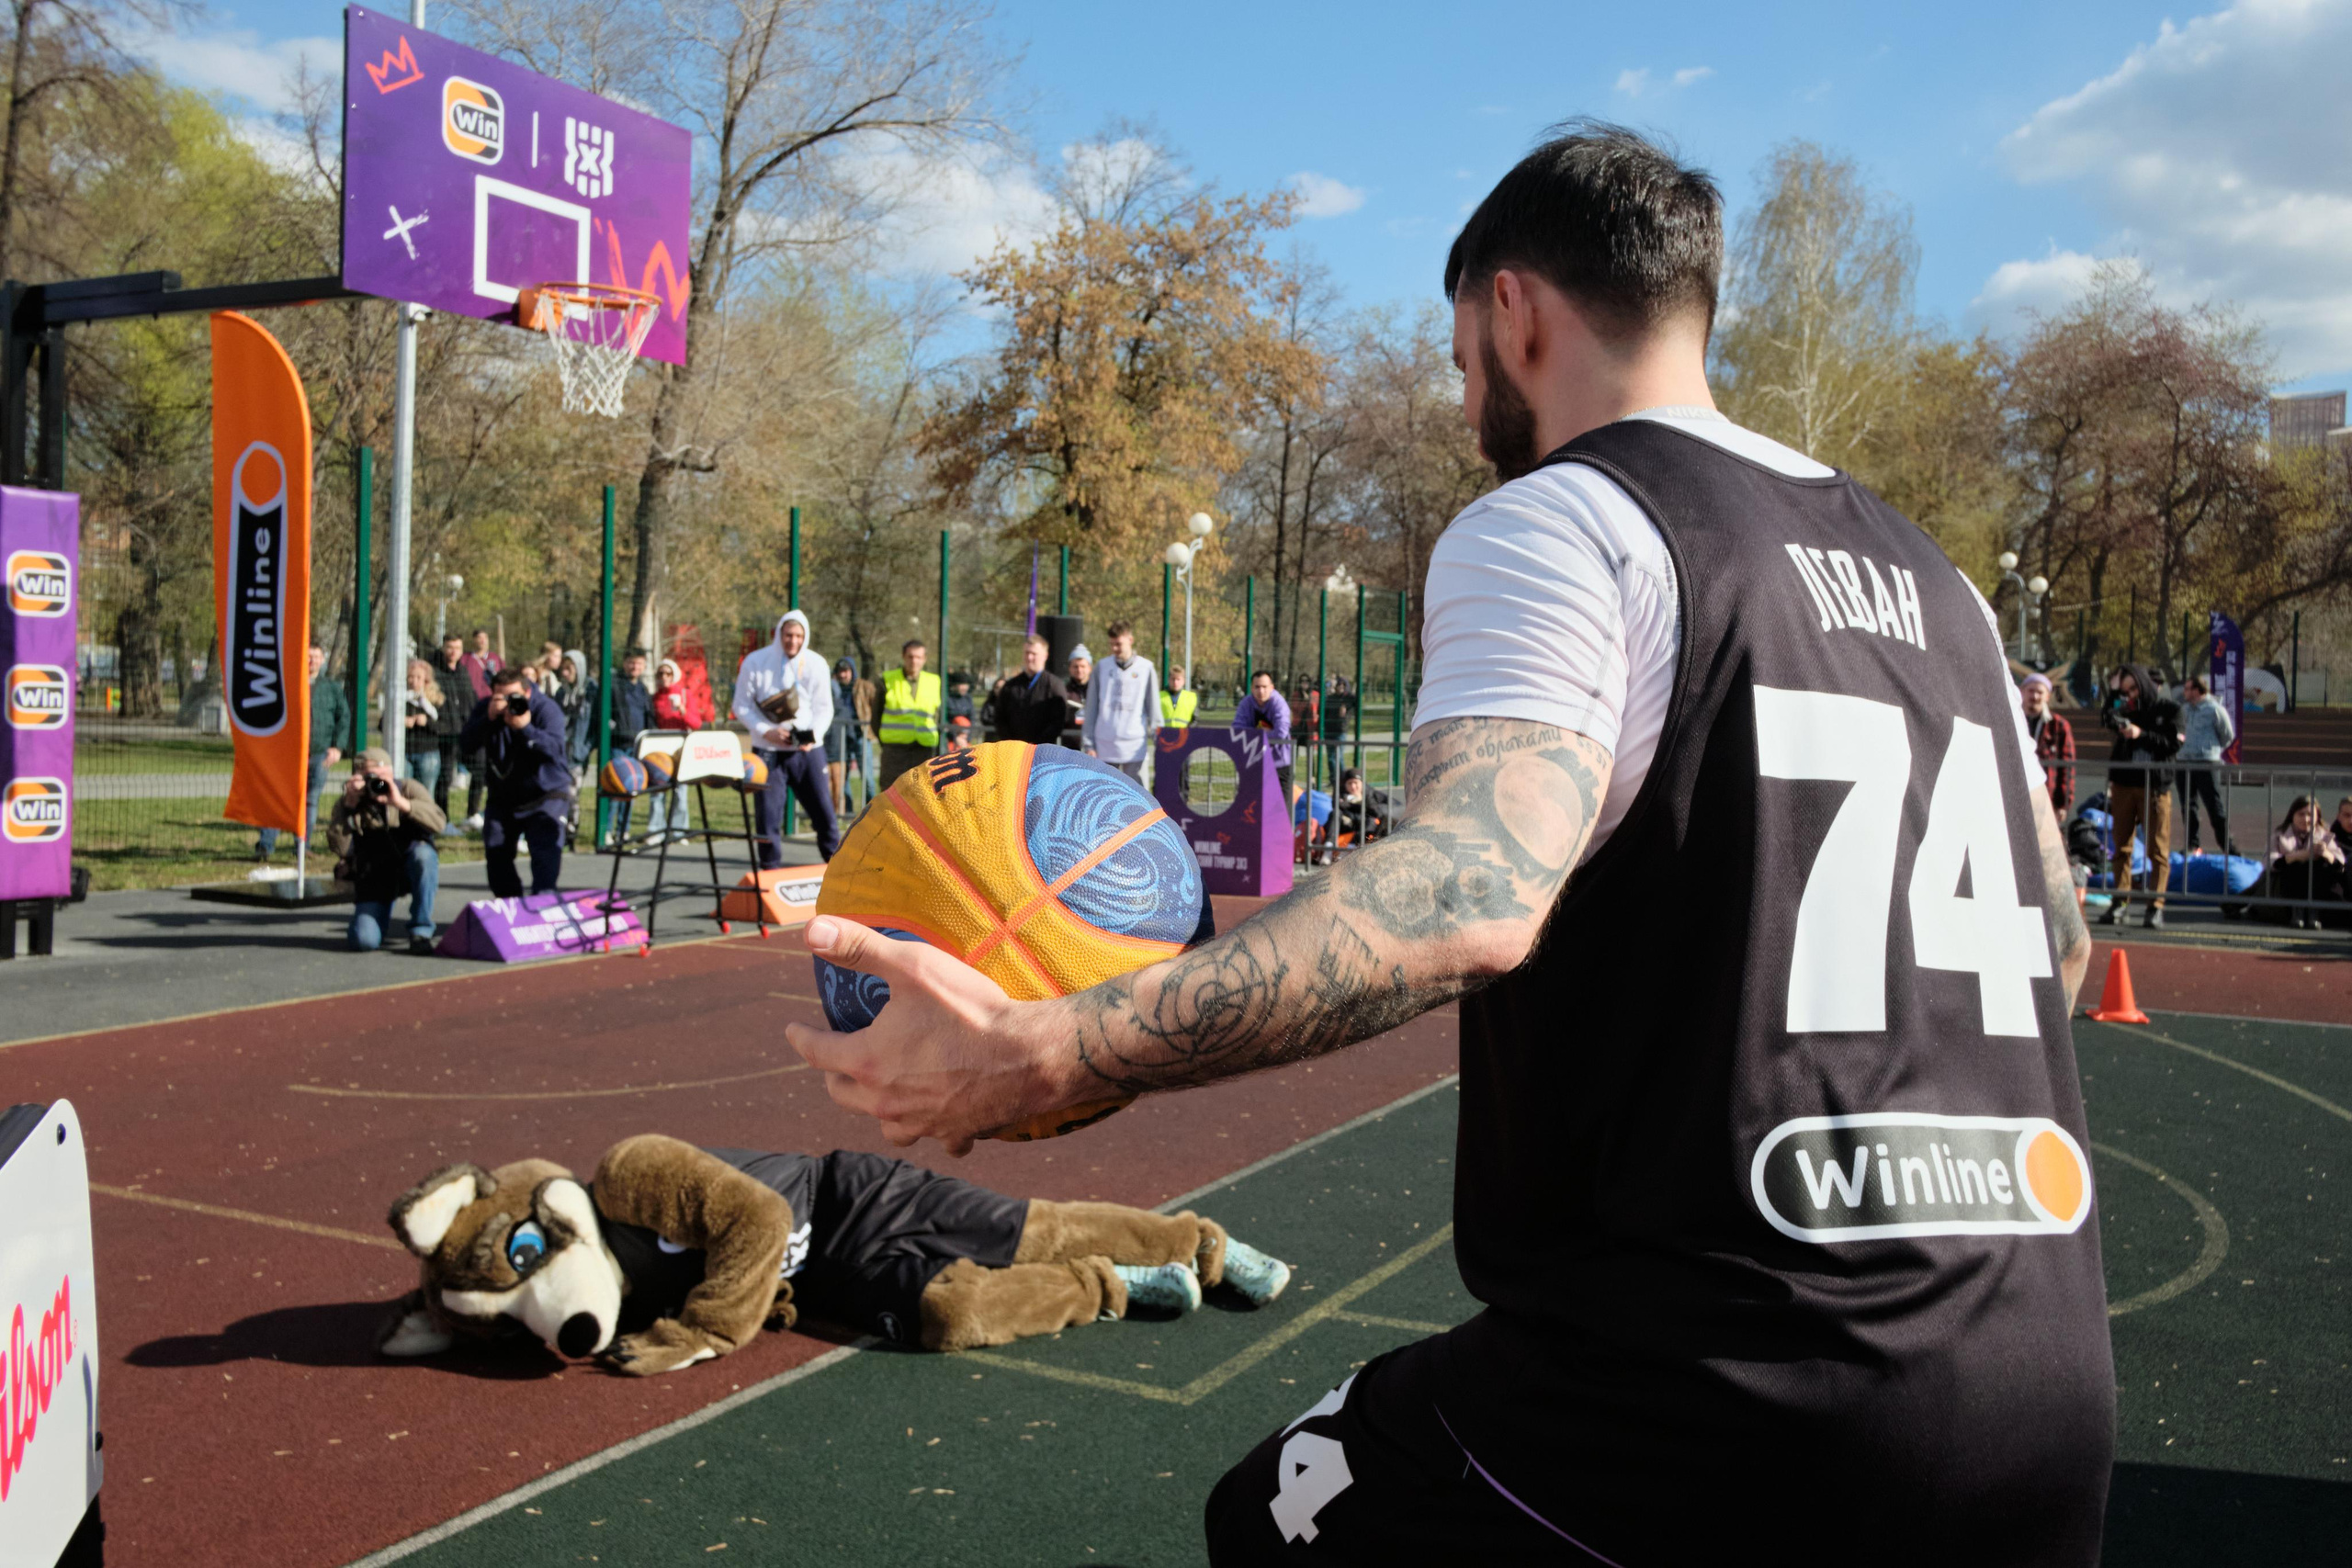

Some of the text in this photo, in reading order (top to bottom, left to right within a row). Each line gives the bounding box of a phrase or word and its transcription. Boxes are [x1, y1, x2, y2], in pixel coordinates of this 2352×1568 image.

[457, 105, 498, 140] Win
[19, 574, 64, 596] Win
[242, 527, 277, 709] Winline
[1784, 543, 1927, 650] ЛЕВАН
[18, 687, 62, 708] Win
[16, 799, 61, 820] Win
[1753, 684, 2053, 1038] 74
[1795, 1142, 2014, 1210] Winline
[0, 1274, 73, 1502] ilson
